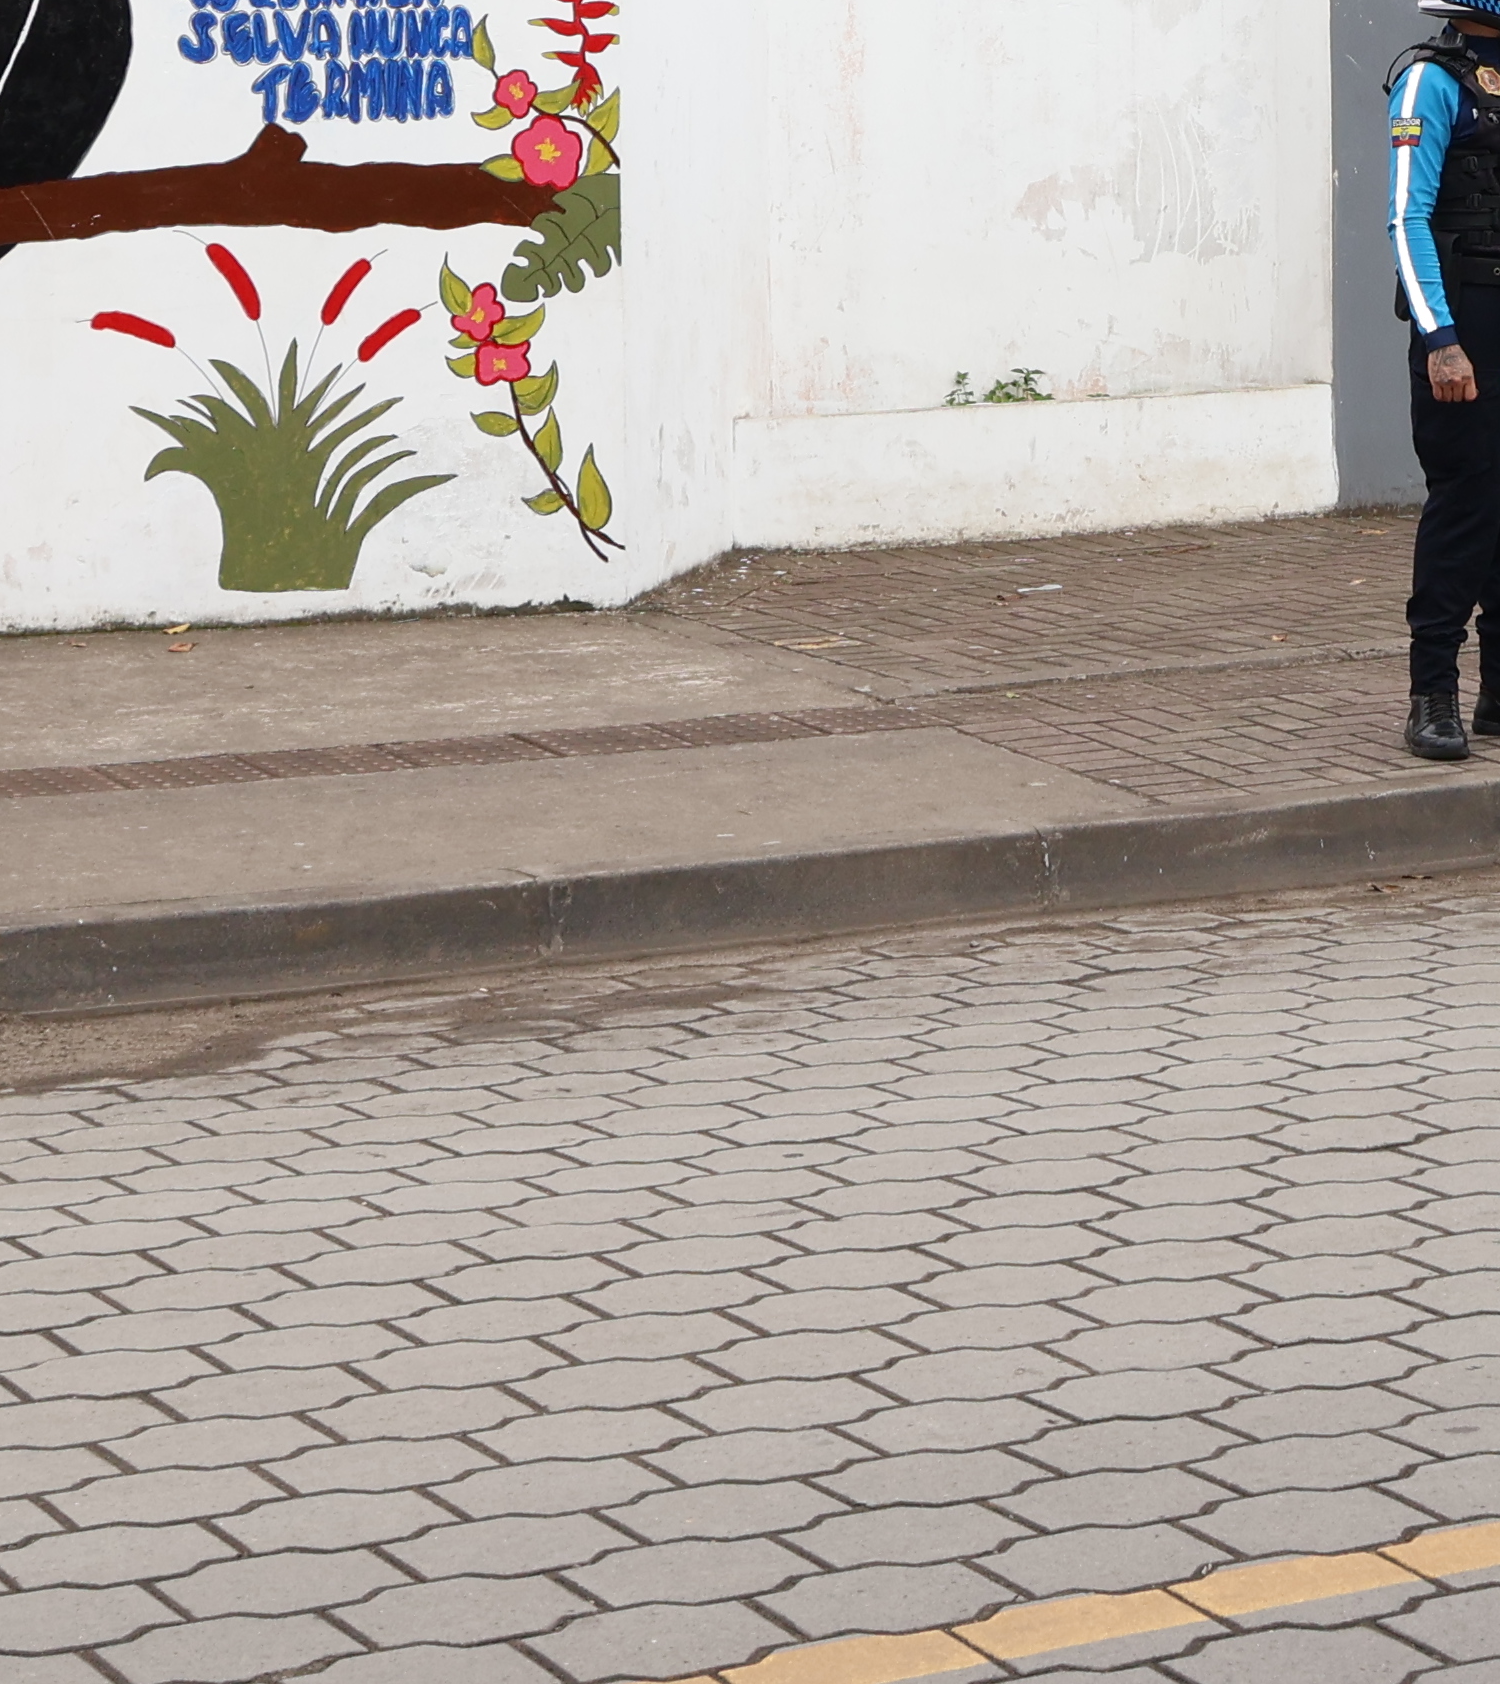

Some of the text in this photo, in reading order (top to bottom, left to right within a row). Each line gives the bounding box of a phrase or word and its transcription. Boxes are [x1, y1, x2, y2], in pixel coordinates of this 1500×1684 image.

[176, 4, 474, 66] SELVA NUNCA
[250, 58, 456, 124] TERMINA
[1392, 118, 1421, 127] ECUADOR
